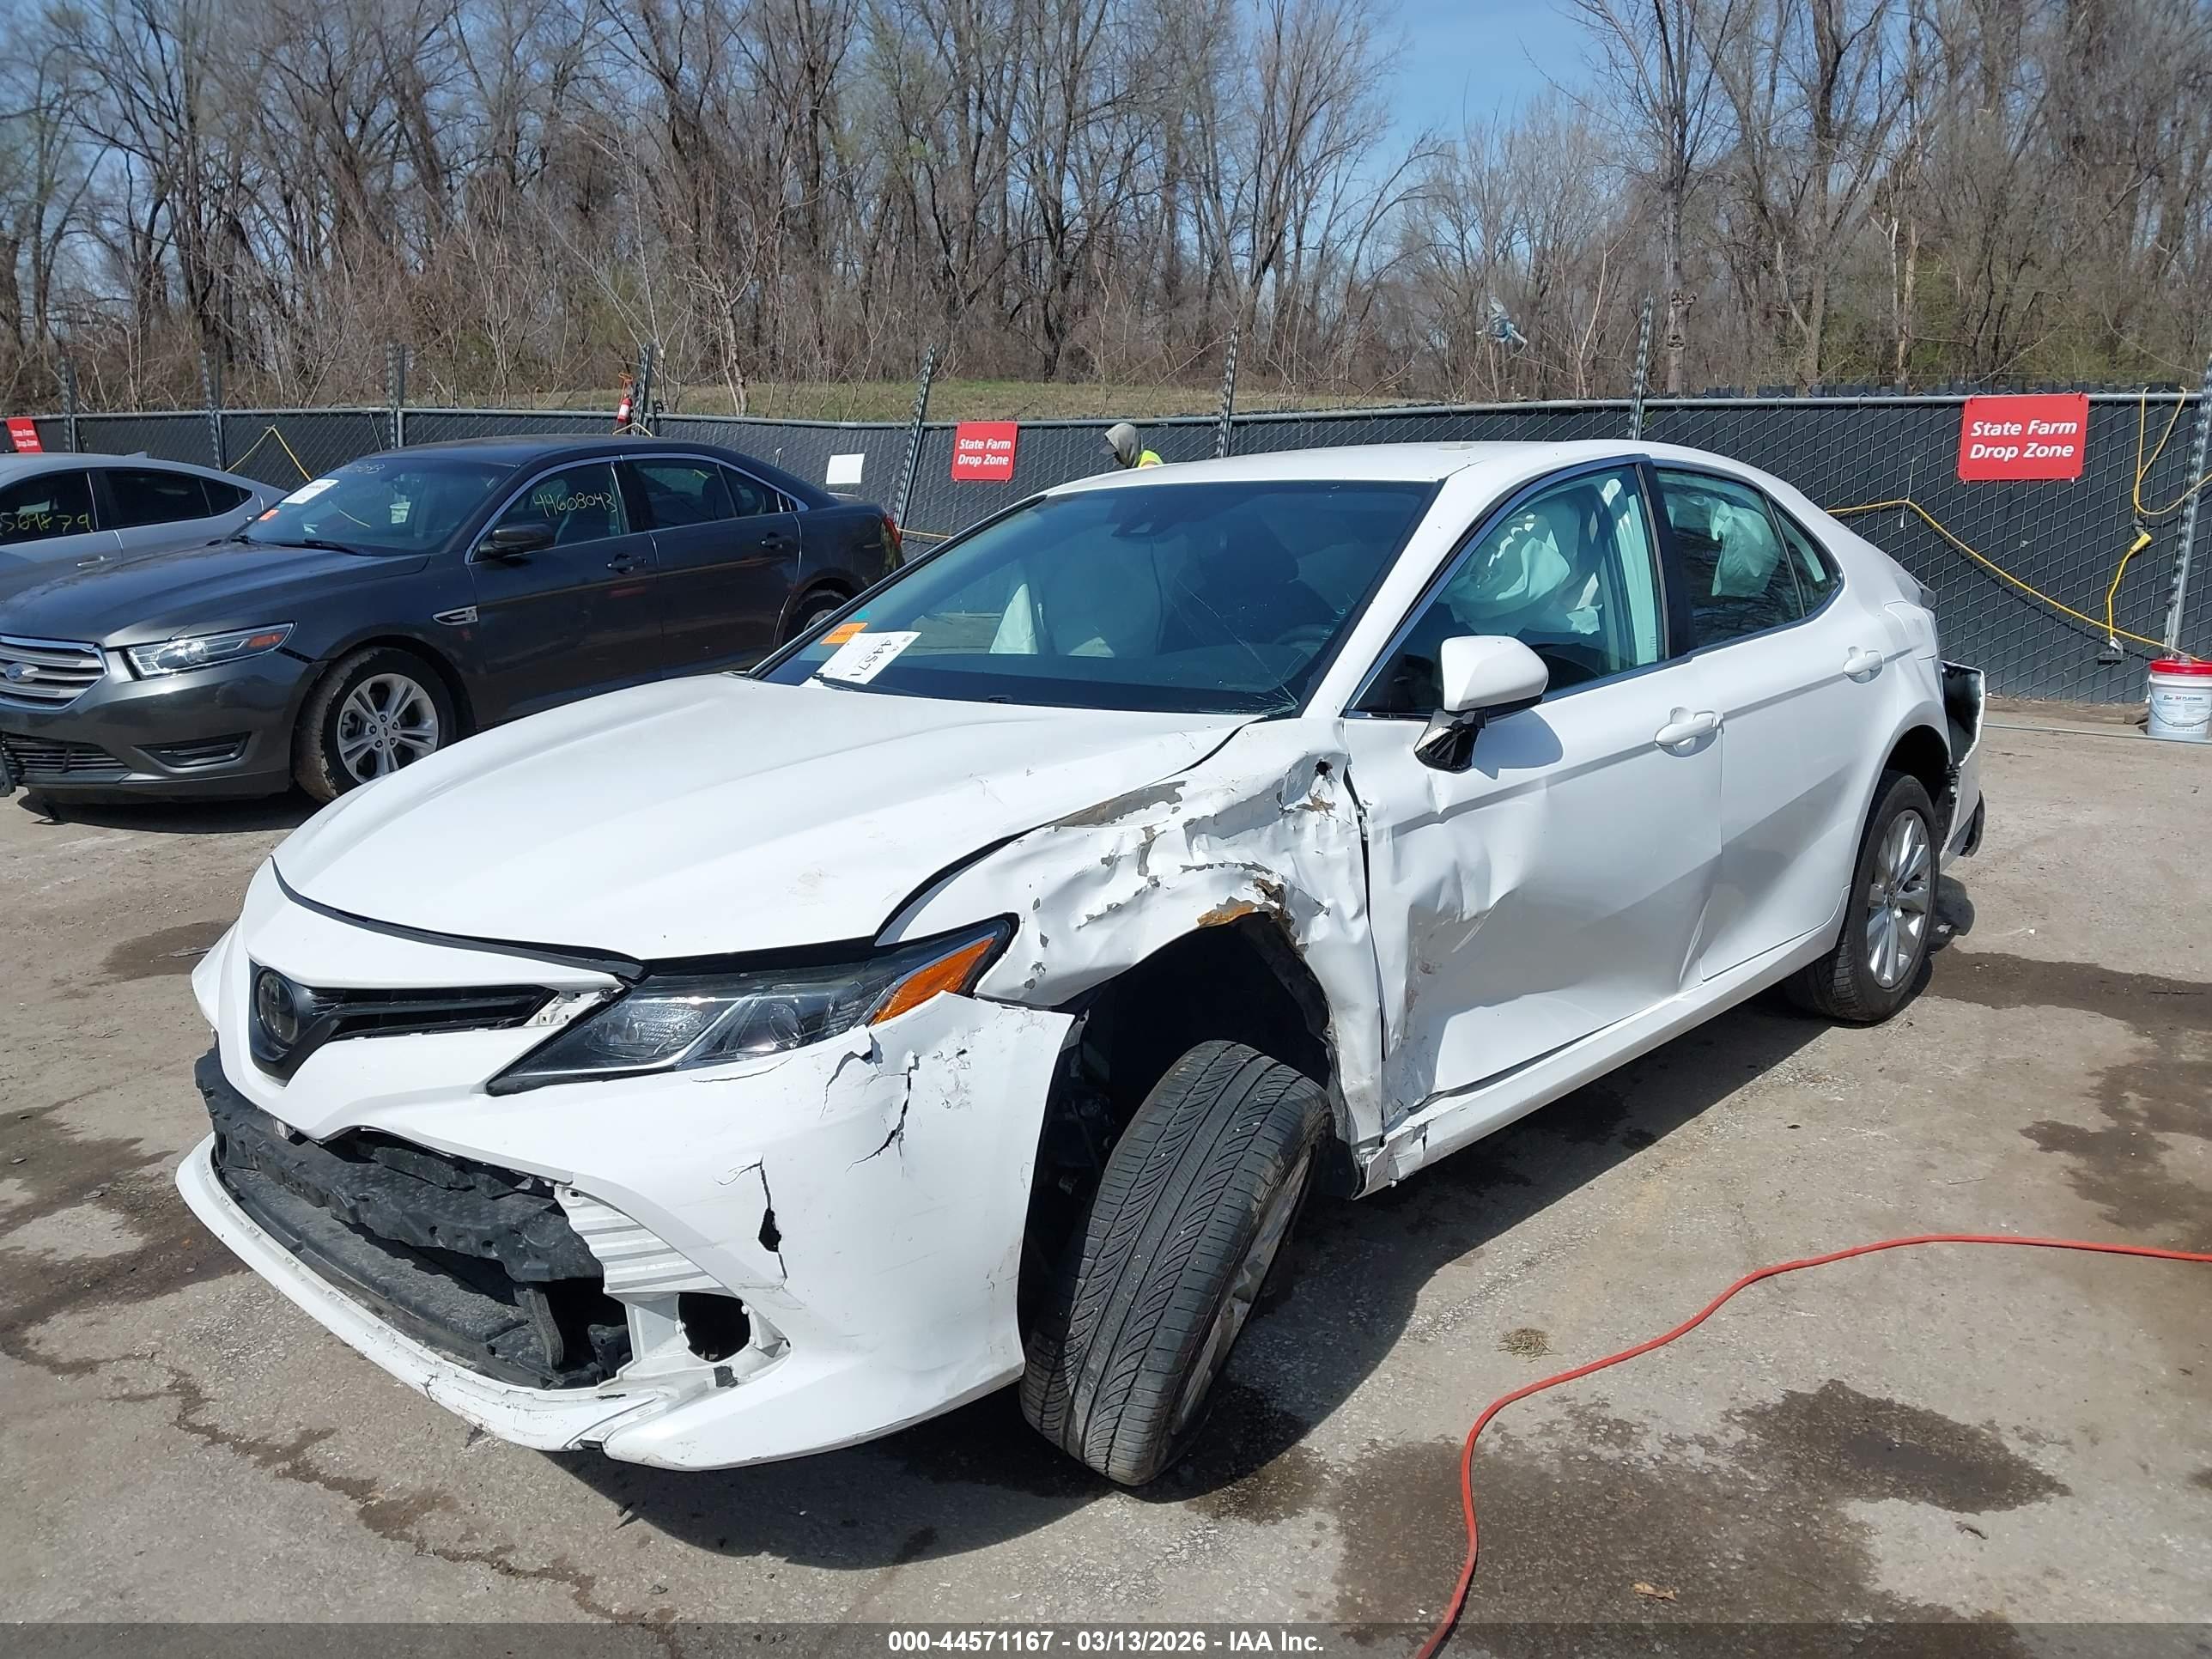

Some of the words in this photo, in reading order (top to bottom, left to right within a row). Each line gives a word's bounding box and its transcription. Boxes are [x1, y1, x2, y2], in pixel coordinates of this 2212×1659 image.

[1971, 421, 2022, 437] State
[2027, 419, 2077, 435] Farm
[958, 438, 985, 450] State
[986, 438, 1012, 450] Farm
[1969, 443, 2019, 462] Drop
[2023, 442, 2075, 459] Zone
[957, 454, 982, 468] Drop
[983, 453, 1009, 465] Zone
[532, 491, 617, 518] 44608043
[0, 513, 92, 536] 569879
